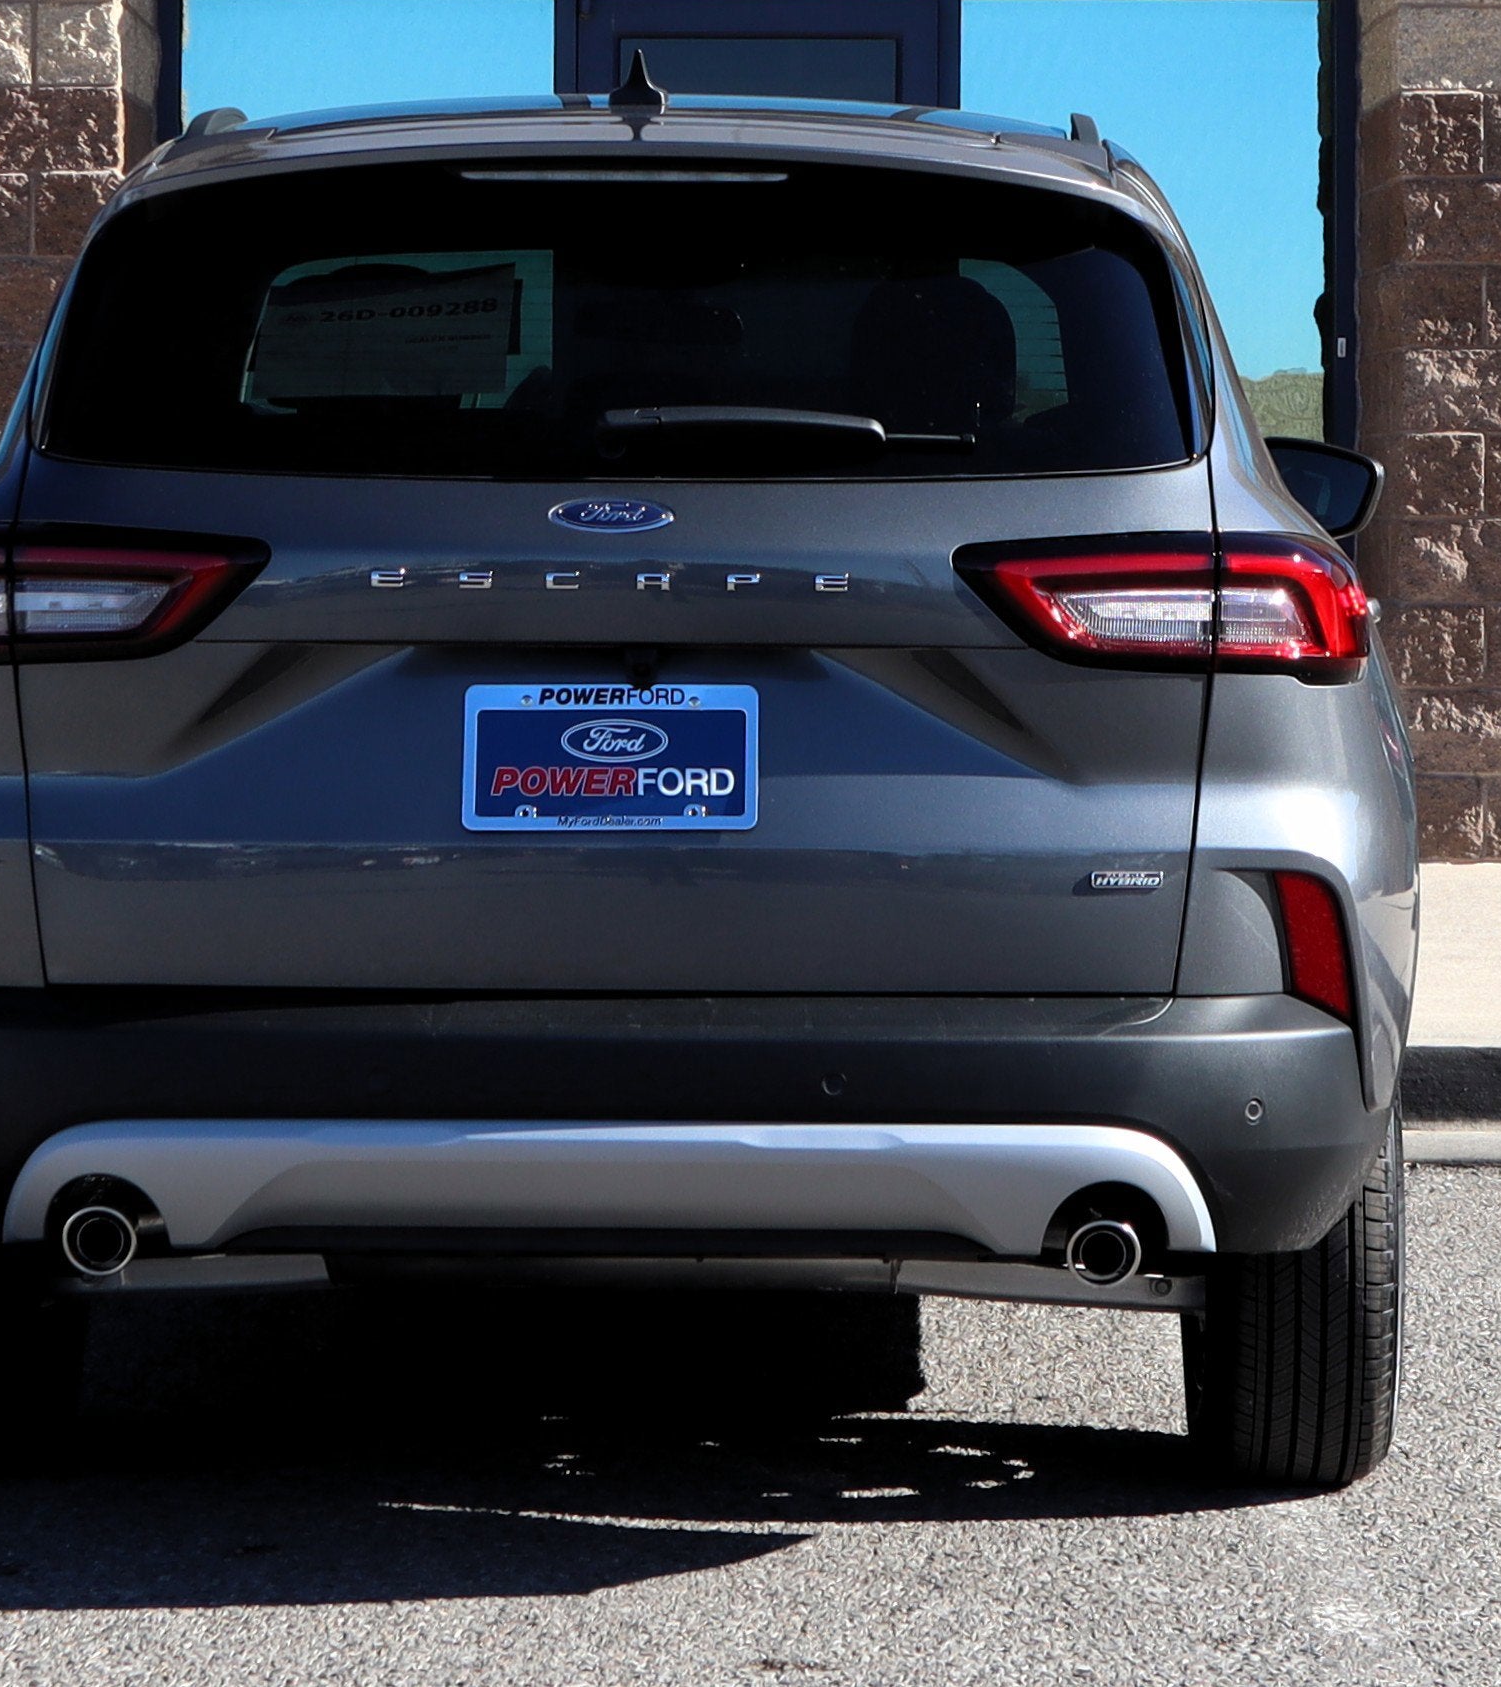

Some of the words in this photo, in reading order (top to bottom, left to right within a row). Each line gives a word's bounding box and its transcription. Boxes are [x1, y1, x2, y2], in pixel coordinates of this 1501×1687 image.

[580, 503, 645, 522] Ford
[371, 569, 849, 592] ESCAPE
[538, 688, 685, 706] POWERFORD
[582, 727, 644, 753] Ford
[490, 766, 735, 797] POWERFORD
[1095, 877, 1160, 886] HYBRID
